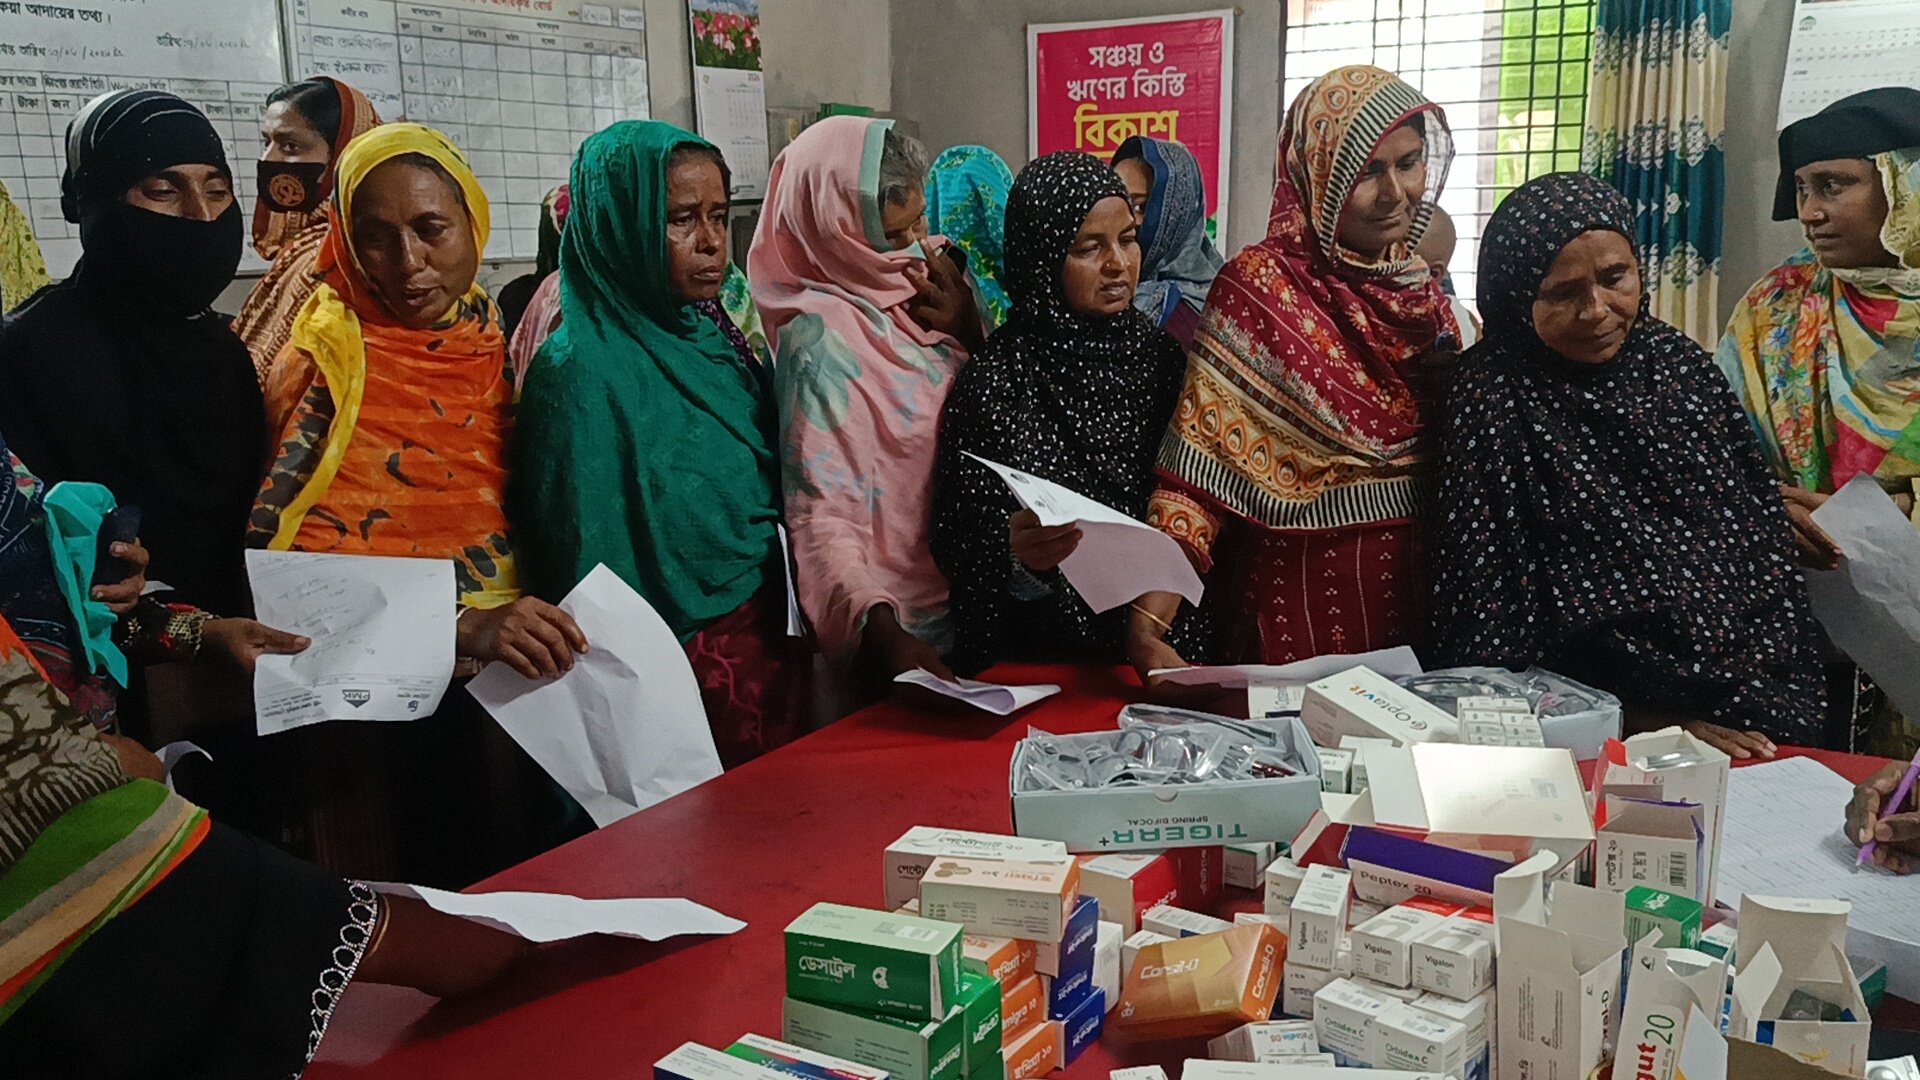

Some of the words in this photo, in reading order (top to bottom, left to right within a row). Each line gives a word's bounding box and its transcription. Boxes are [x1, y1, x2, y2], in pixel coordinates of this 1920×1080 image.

[1088, 43, 1144, 68] সঞ্চয়
[1149, 41, 1164, 63] ও
[1067, 76, 1127, 101] ঋণের
[1132, 66, 1187, 98] কিস্তি
[1073, 103, 1179, 148] বিকাশ
[343, 691, 371, 700] PMK
[1349, 684, 1411, 722] Optavit
[1127, 817, 1169, 826] BIFOCAL
[1171, 815, 1208, 824] SPRING
[1360, 870, 1409, 890] Peptex
[1414, 883, 1431, 895] 20
[1363, 942, 1392, 956] Vigalon
[1425, 954, 1455, 968] Vigalon
[1324, 1017, 1357, 1035] Orbidex
[1358, 1028, 1365, 1037] C
[1643, 1014, 1675, 1045] 20
[1384, 1043, 1420, 1061] Orbidex
[1420, 1056, 1428, 1064] C
